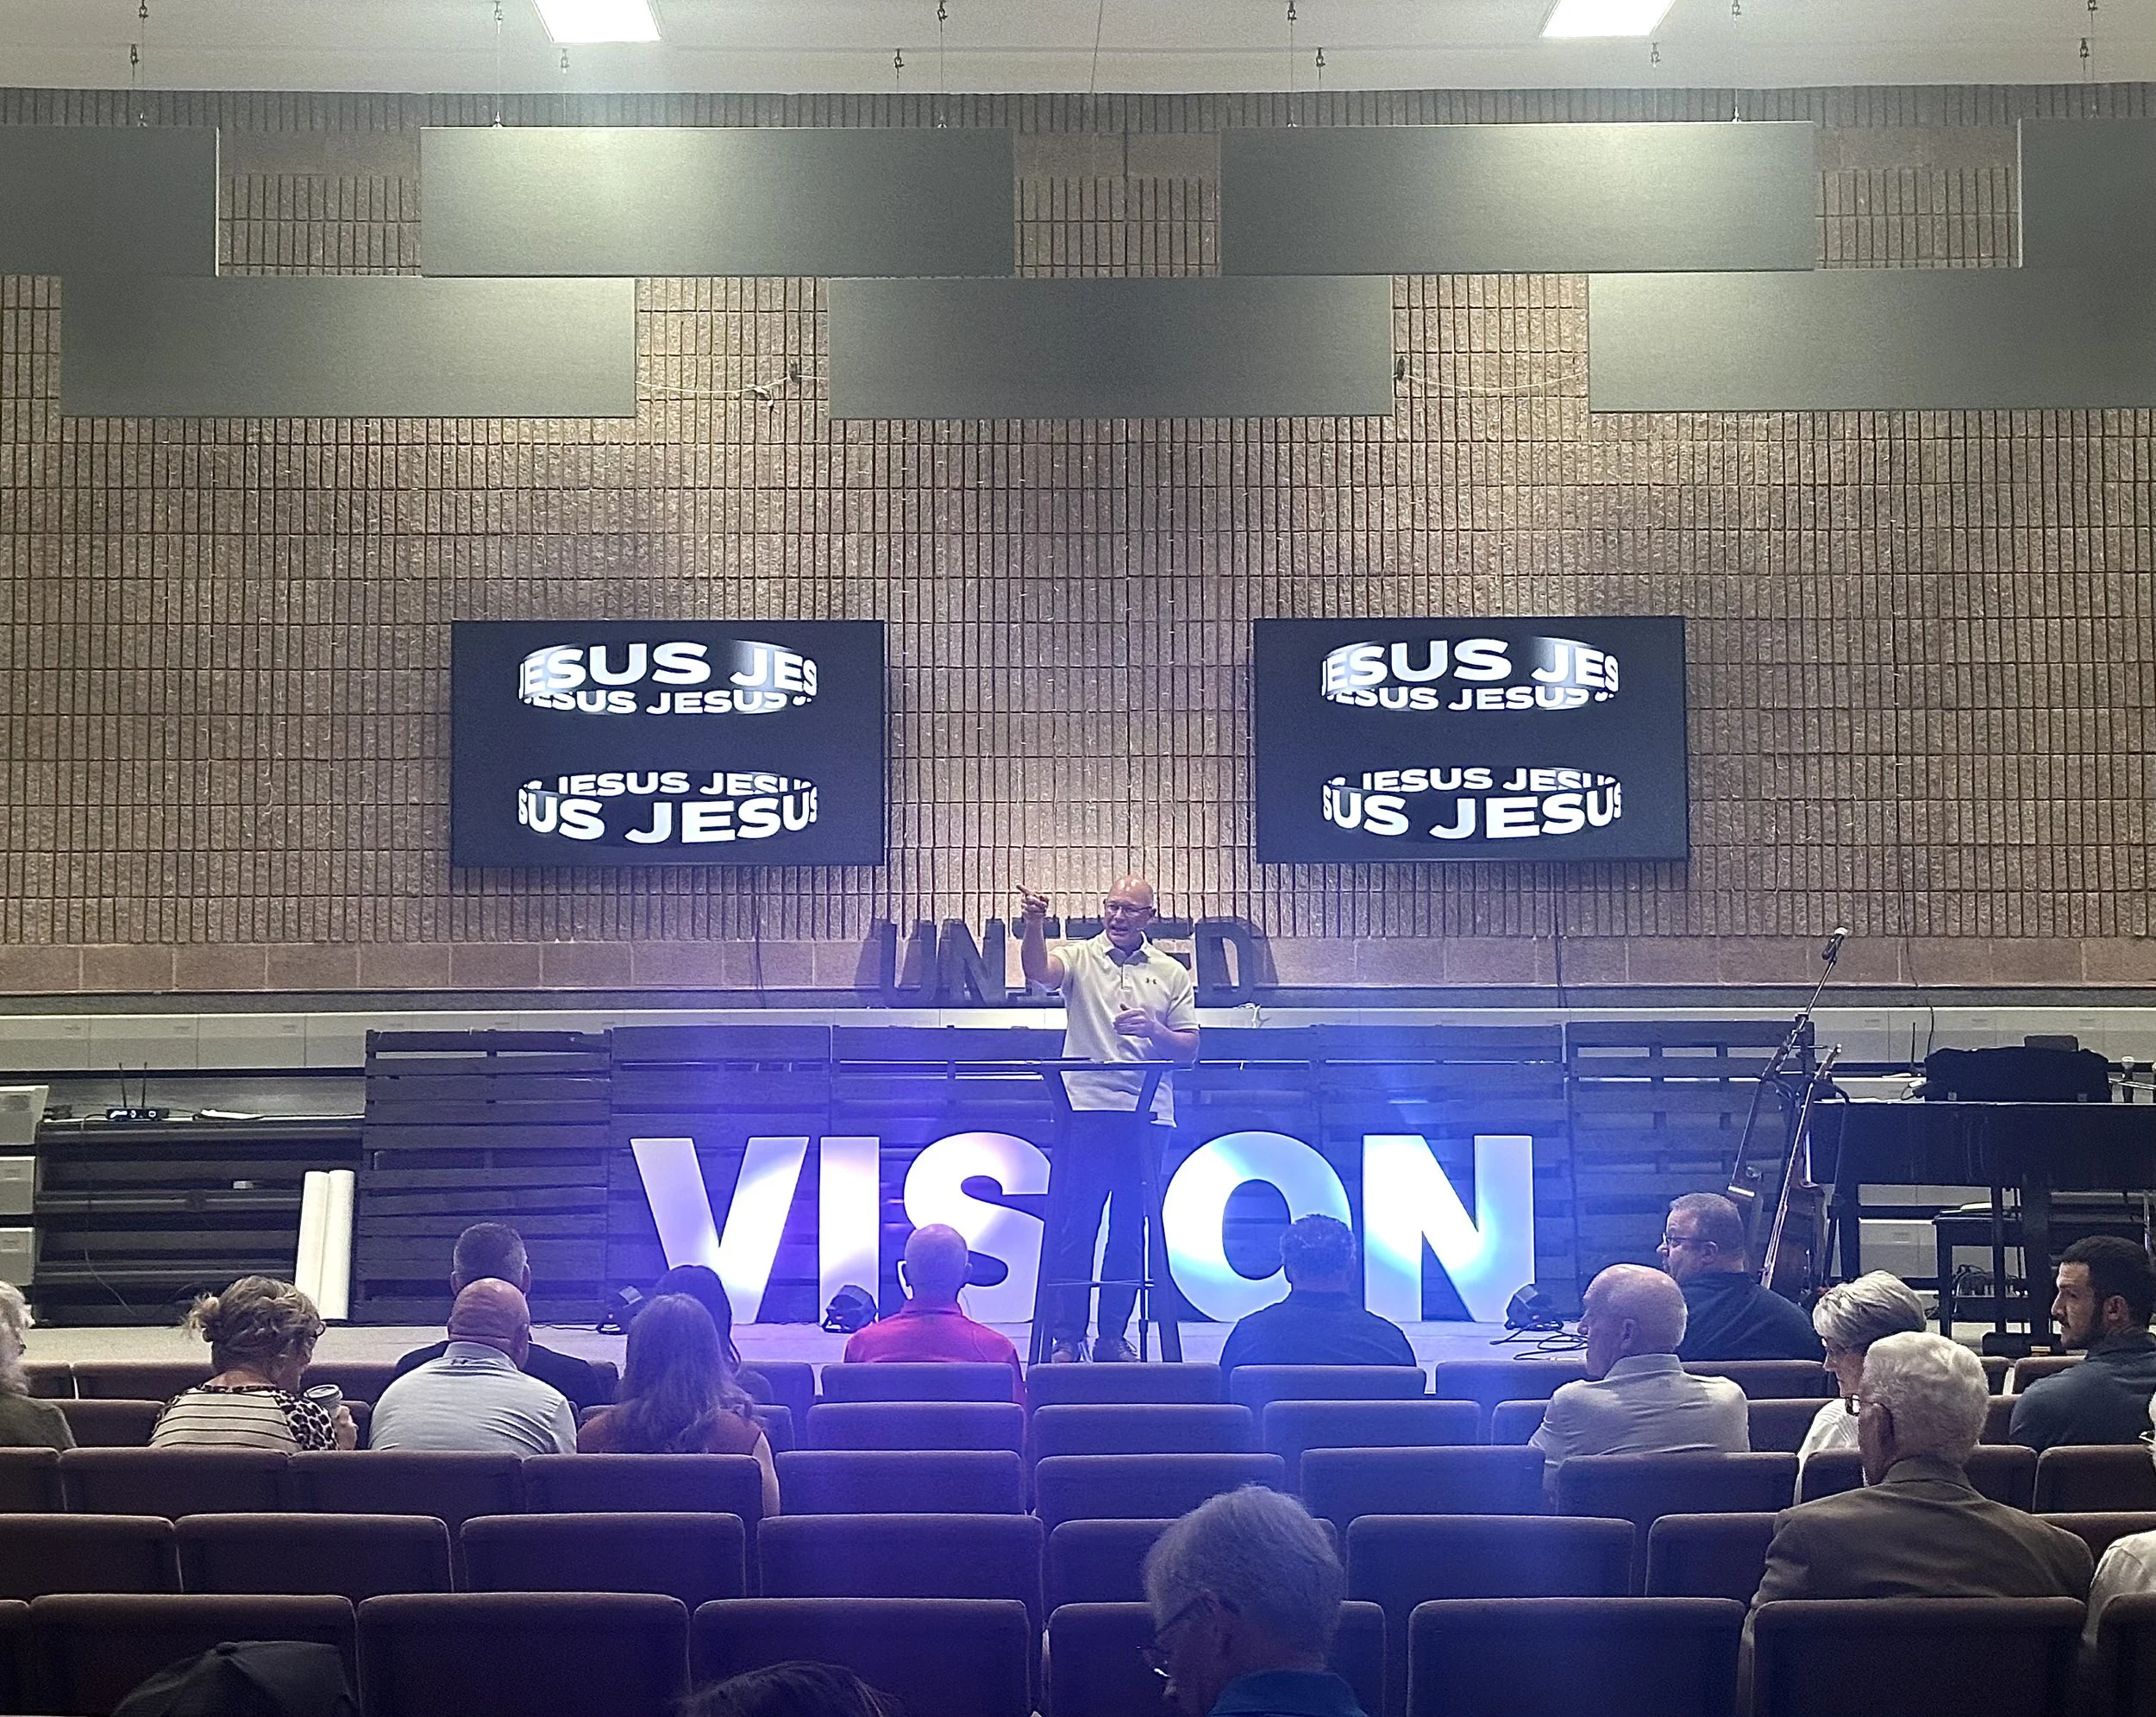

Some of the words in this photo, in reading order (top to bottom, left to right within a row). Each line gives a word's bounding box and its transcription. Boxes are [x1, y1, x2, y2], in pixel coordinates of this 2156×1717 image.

[730, 647, 818, 697] JES
[1531, 642, 1620, 692] JES
[624, 786, 818, 844] JESUS
[1428, 781, 1621, 840] JESUS
[630, 1131, 1535, 1325] VISON
